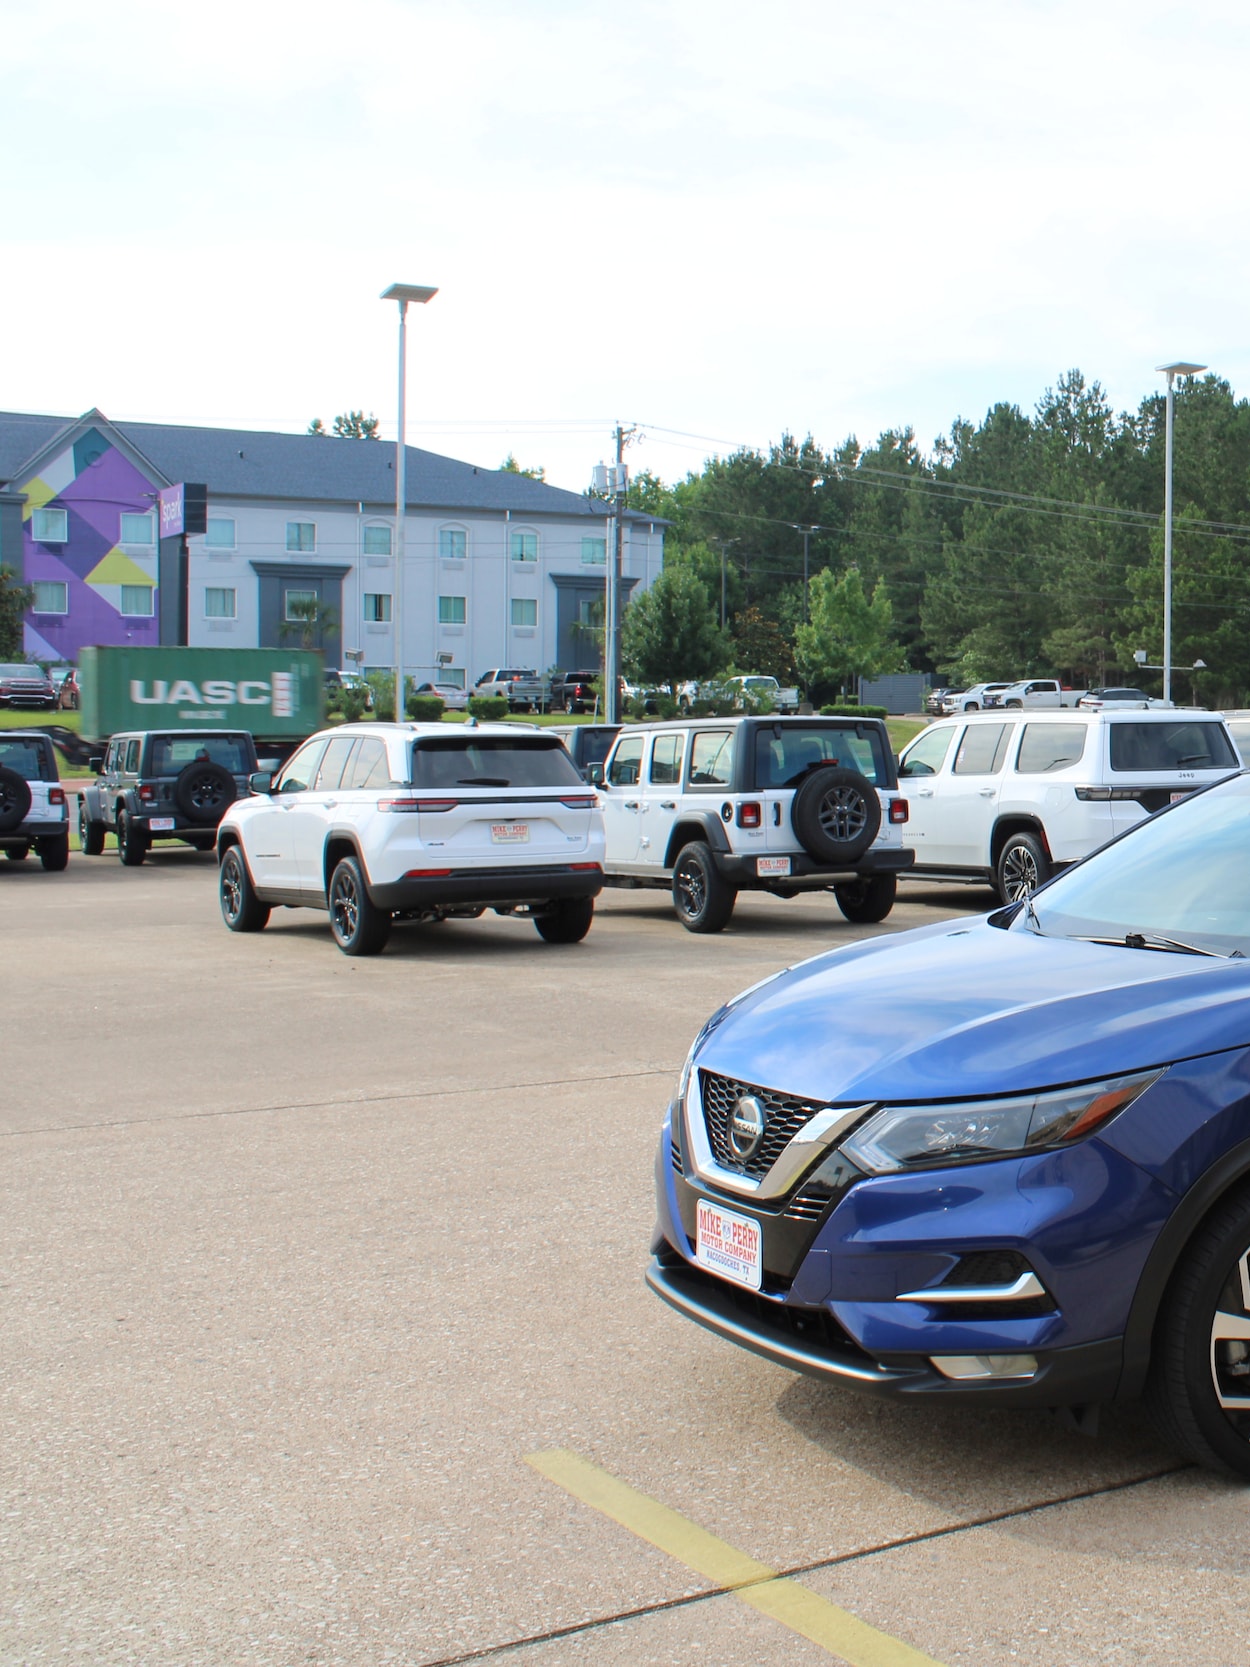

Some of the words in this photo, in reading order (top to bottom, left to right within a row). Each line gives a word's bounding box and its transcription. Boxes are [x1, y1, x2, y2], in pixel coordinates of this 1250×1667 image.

[163, 491, 183, 530] spark
[131, 680, 271, 704] UASC
[700, 1208, 722, 1237] MIKE
[732, 1222, 758, 1251] PERRY
[701, 1231, 723, 1250] MOTOR
[724, 1241, 757, 1264] COMPANY
